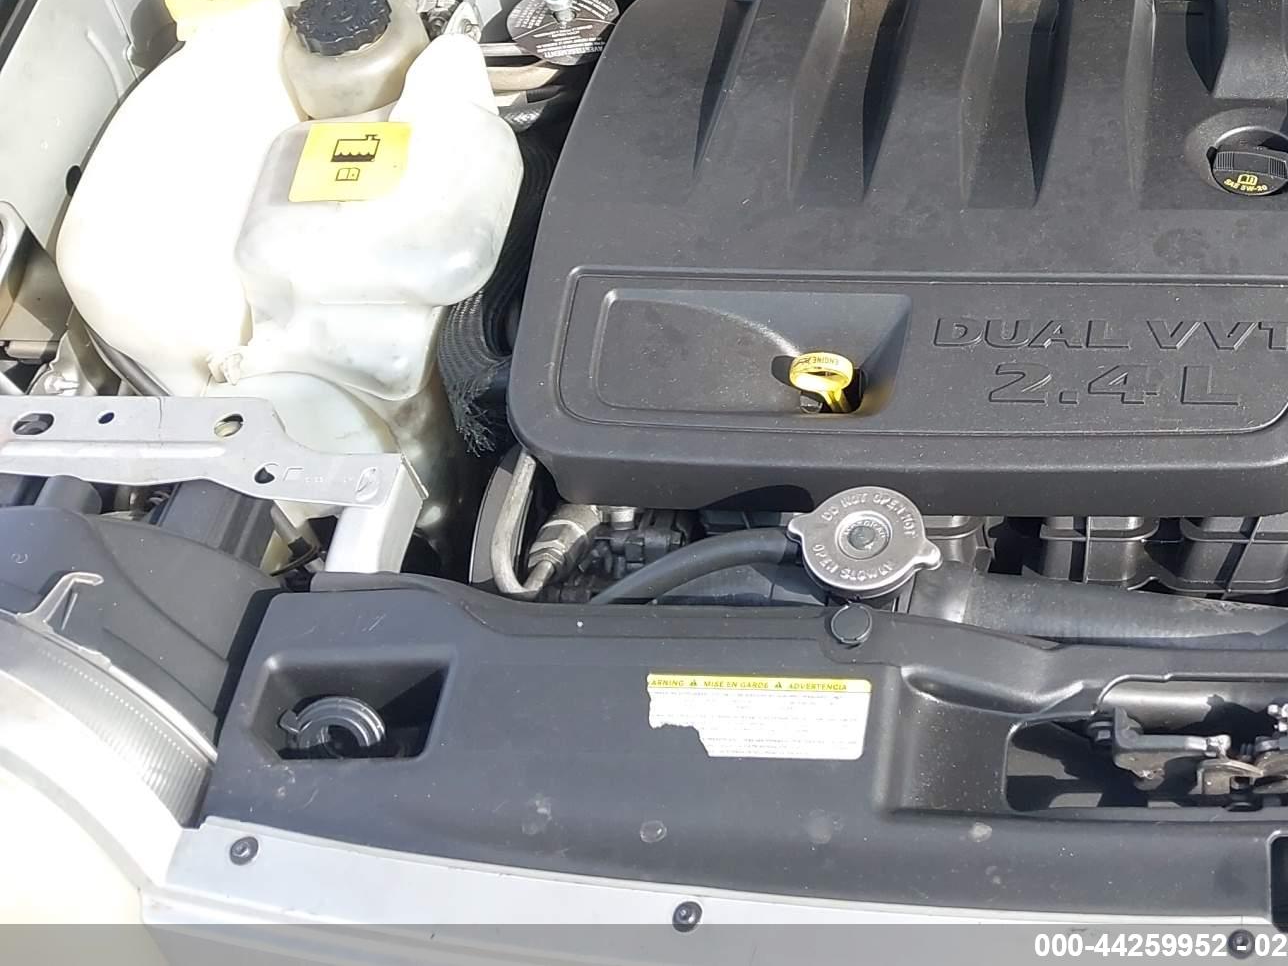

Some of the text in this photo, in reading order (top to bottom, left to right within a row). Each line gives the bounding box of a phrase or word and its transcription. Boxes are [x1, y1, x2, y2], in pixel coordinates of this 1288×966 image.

[1224, 178, 1268, 192] SAE 5W-20
[933, 317, 1130, 350] DUAL
[813, 356, 839, 365] ENGINE
[822, 506, 839, 522] DO
[840, 493, 868, 509] NOT
[648, 680, 685, 688] ARNING
[740, 682, 769, 690] GARDE
[789, 683, 848, 692] ADVERTENCIA
